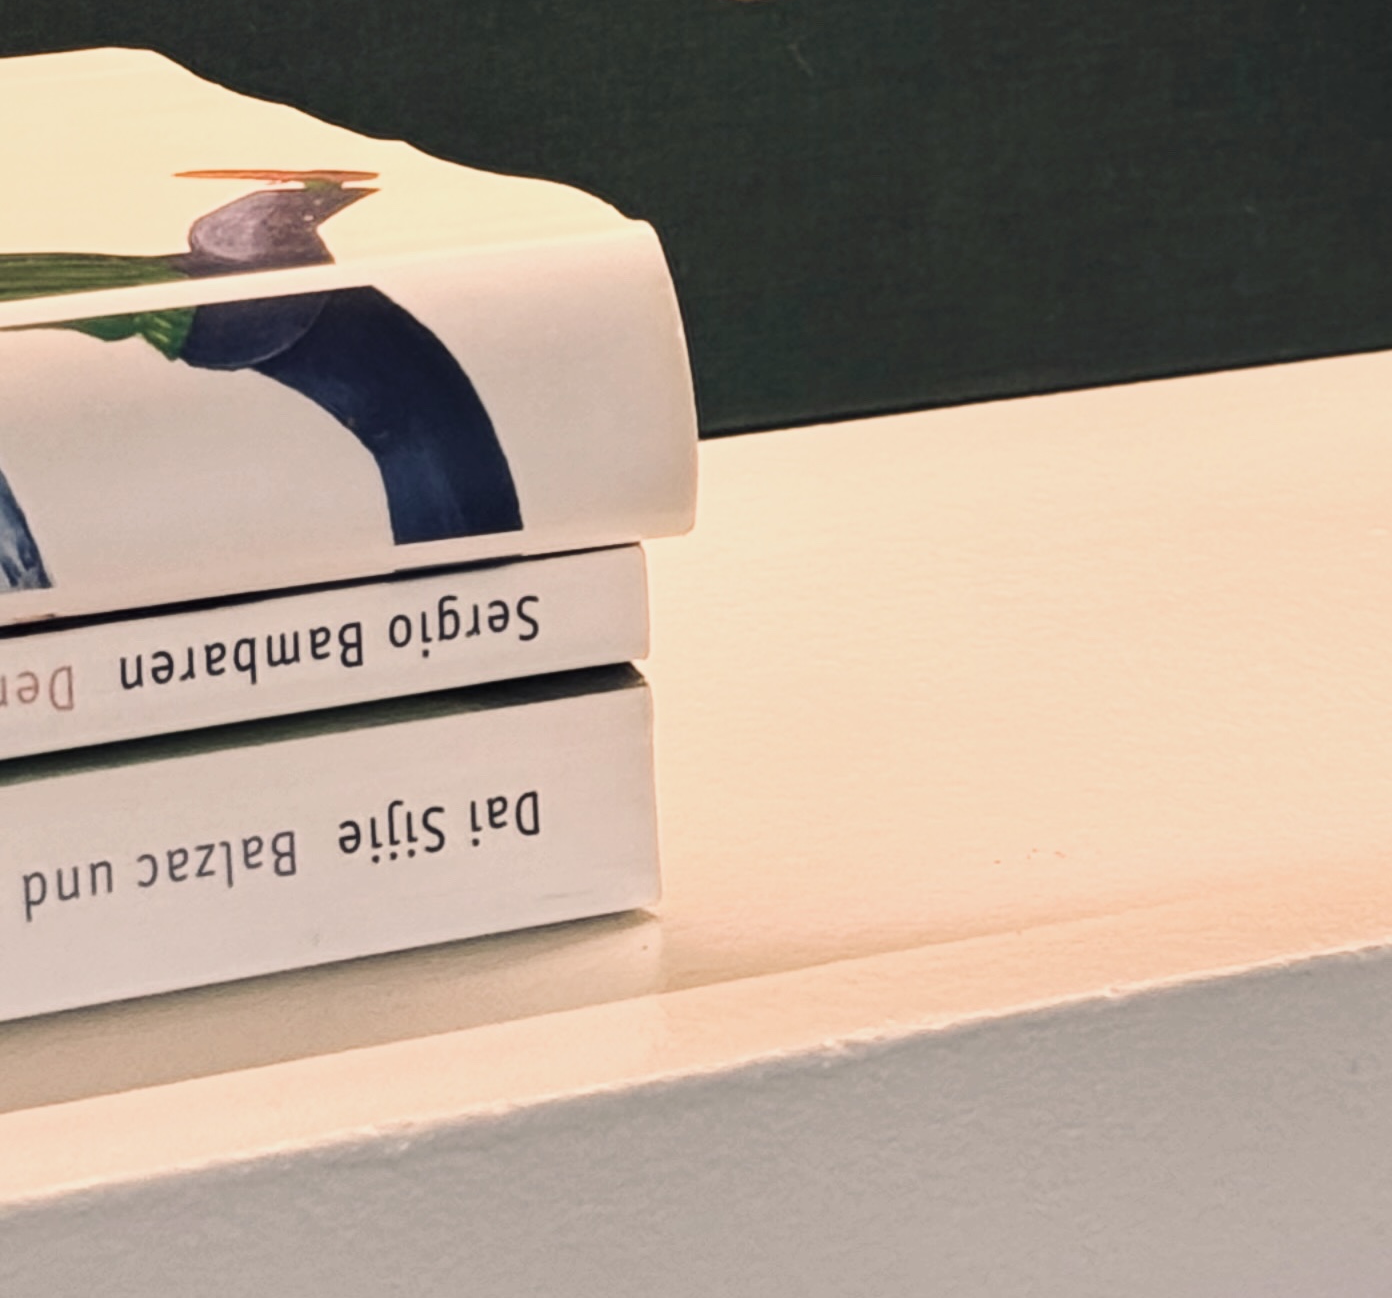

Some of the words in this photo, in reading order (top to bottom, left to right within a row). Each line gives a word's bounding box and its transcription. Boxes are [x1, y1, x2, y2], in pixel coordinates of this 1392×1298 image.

[118, 620, 365, 691] Bambaren
[387, 594, 541, 659] Sergio
[337, 800, 447, 866] Sijie
[468, 790, 541, 847] Dai
[20, 860, 115, 923] und
[137, 830, 298, 889] Balzac
